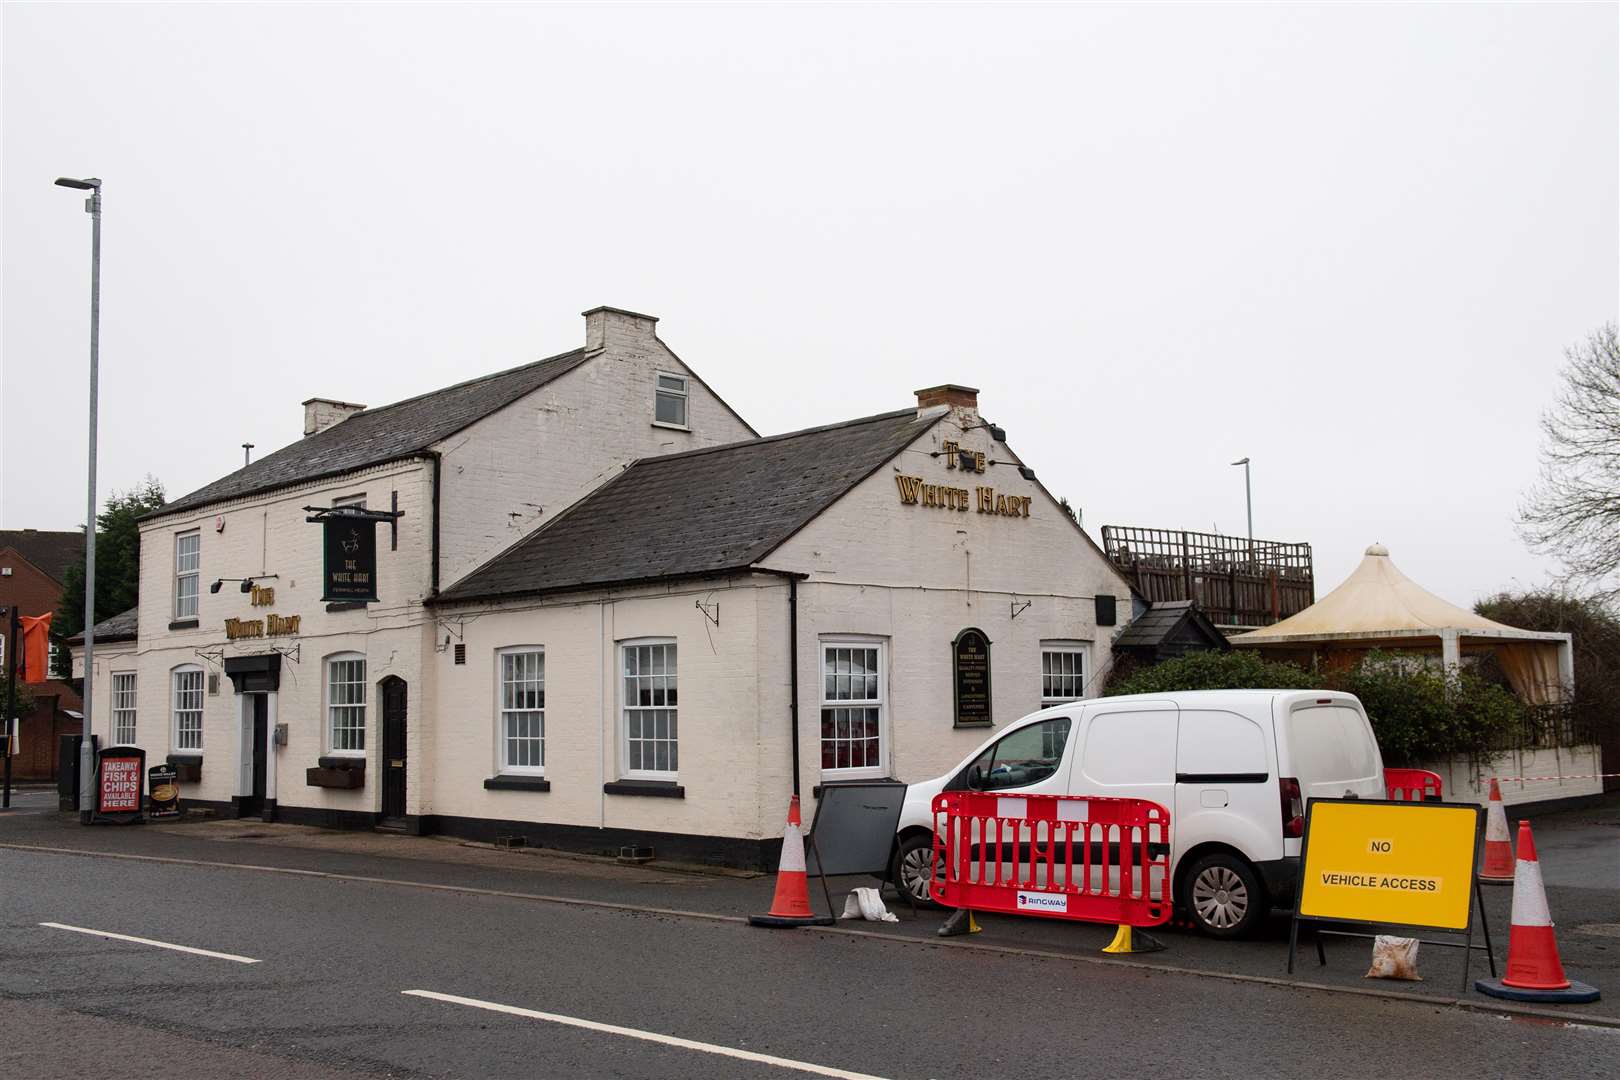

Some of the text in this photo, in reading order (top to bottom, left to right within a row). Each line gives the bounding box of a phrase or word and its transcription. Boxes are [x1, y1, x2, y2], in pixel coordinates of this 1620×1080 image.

[895, 475, 1032, 518] WHITE HART
[345, 560, 357, 570] THE
[332, 572, 351, 582] WHITE
[224, 613, 301, 639] WHITE HART
[103, 762, 137, 772] TAKEAWAY
[103, 772, 137, 782] FISH &
[103, 782, 137, 792] CHIPS
[103, 792, 136, 800] AVAILABLE
[1371, 841, 1392, 852] NO
[1322, 874, 1436, 891] VEHICLE ACCESS
[1028, 897, 1066, 906] RINGWAY
